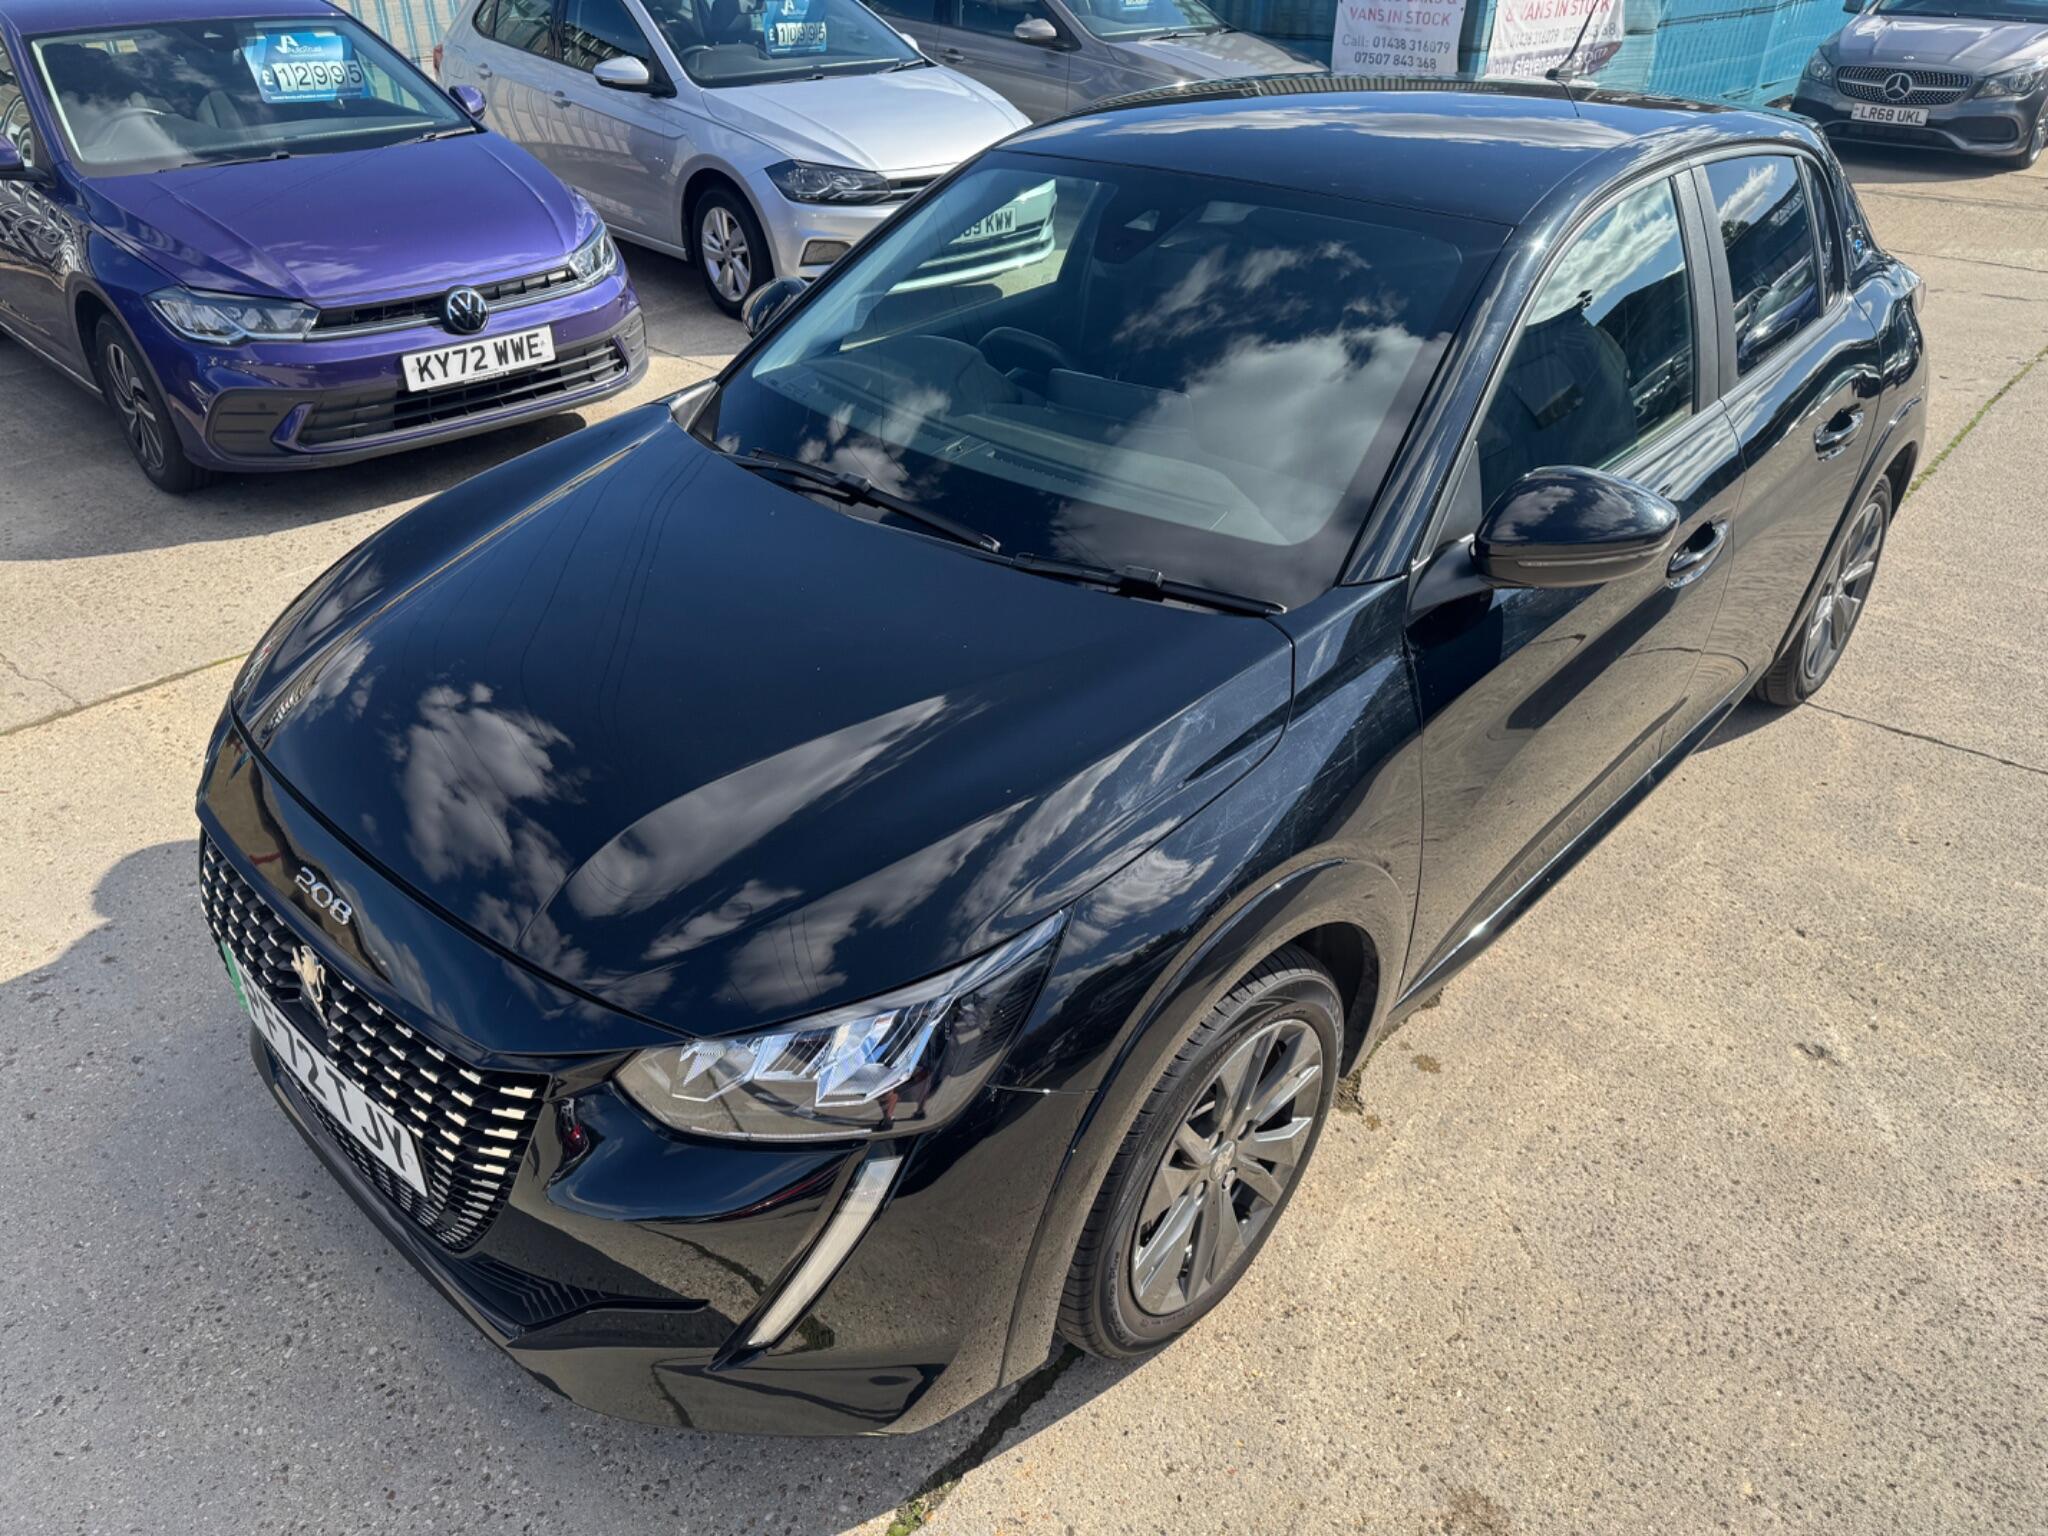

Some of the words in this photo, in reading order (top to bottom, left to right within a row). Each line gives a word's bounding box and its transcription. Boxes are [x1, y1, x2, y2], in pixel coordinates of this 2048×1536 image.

[1350, 7, 1385, 22] VANS
[1386, 9, 1402, 24] IN
[1405, 11, 1452, 26] STOCK
[1571, 0, 1608, 16] STOK
[1372, 35, 1407, 50] 01438
[1408, 40, 1451, 54] 316079
[1354, 51, 1391, 67] 07507
[1393, 54, 1414, 68] 843
[1416, 57, 1437, 71] 368
[1860, 105, 1895, 121] LR68
[1896, 109, 1923, 124] UKL
[984, 210, 1013, 234] KWW
[415, 345, 488, 382] KY72
[493, 333, 543, 366] WWE
[294, 866, 353, 925] 208
[325, 1065, 407, 1172] TJY
